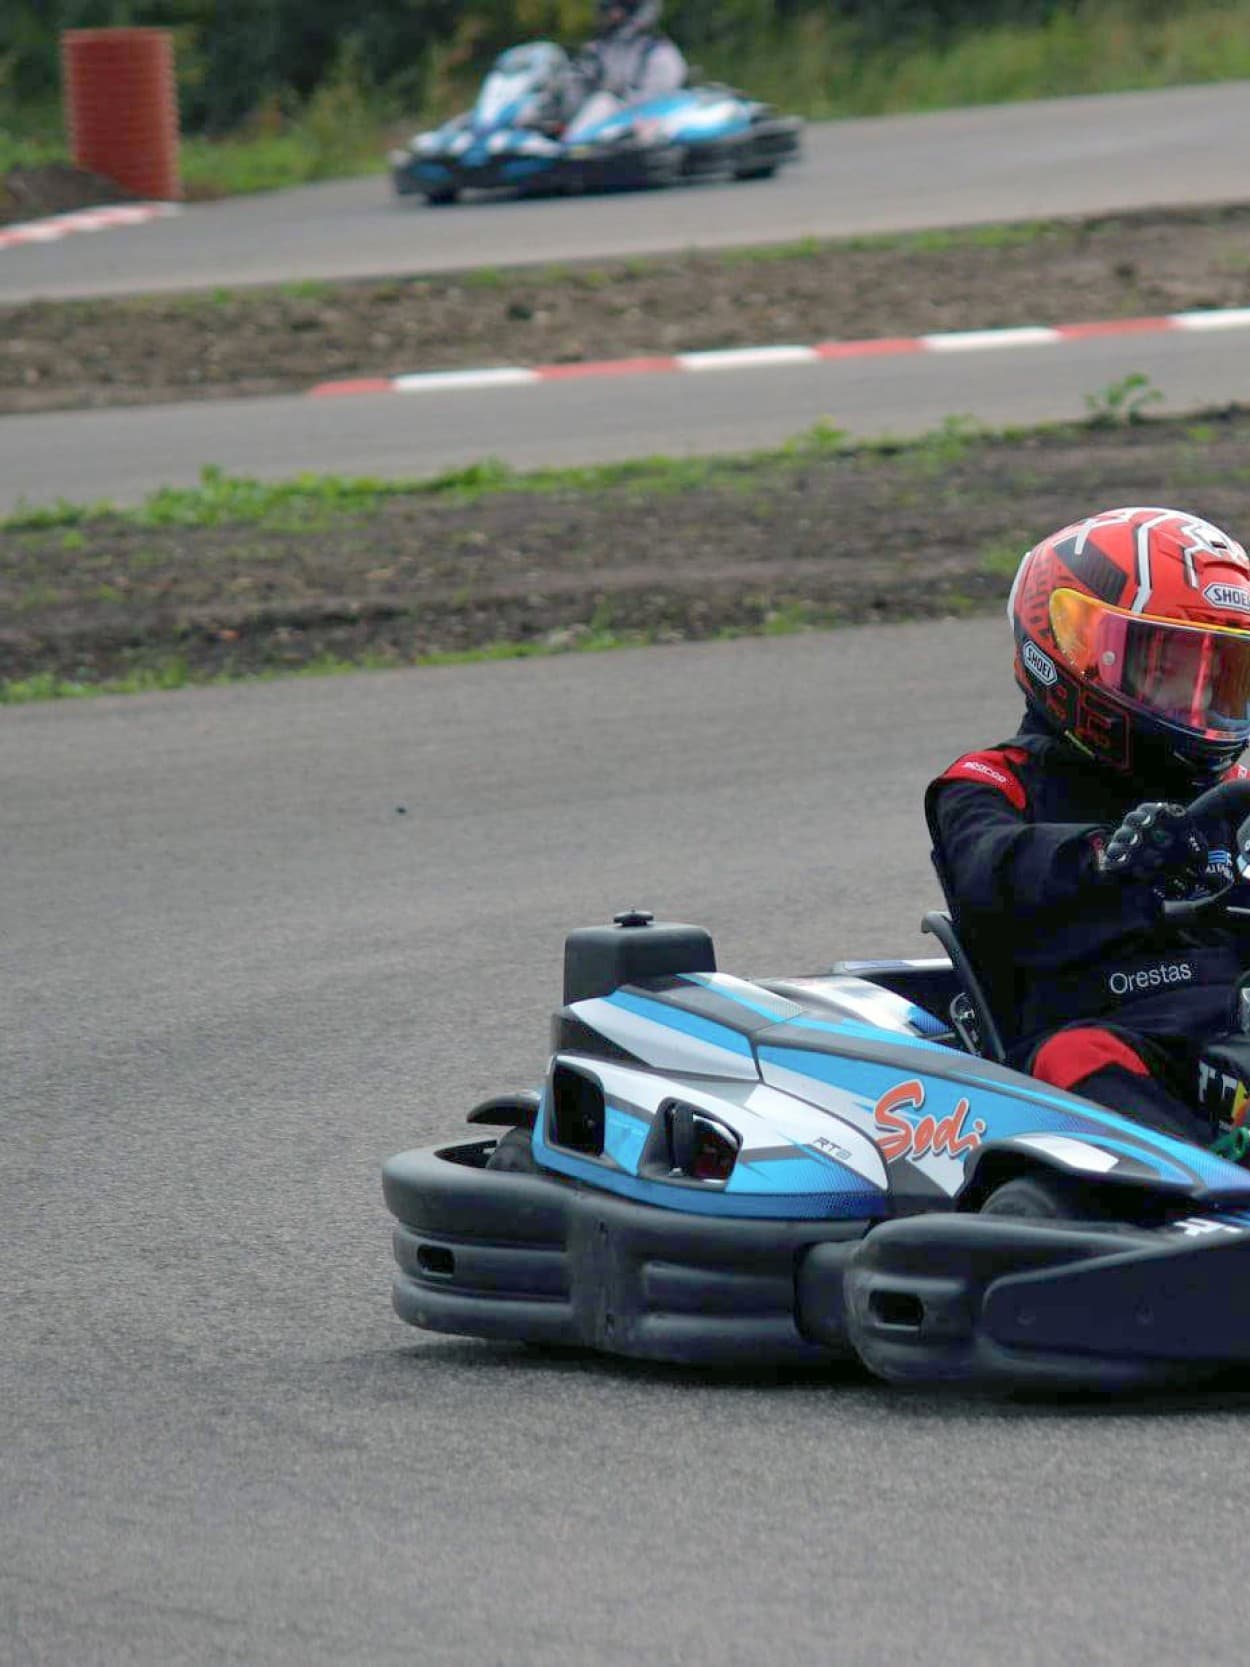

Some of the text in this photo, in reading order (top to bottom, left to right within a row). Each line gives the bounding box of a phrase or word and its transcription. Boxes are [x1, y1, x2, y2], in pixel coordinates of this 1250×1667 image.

[1026, 646, 1052, 678] SHOEI
[1110, 963, 1192, 994] Orestas
[874, 1079, 986, 1162] Sodi
